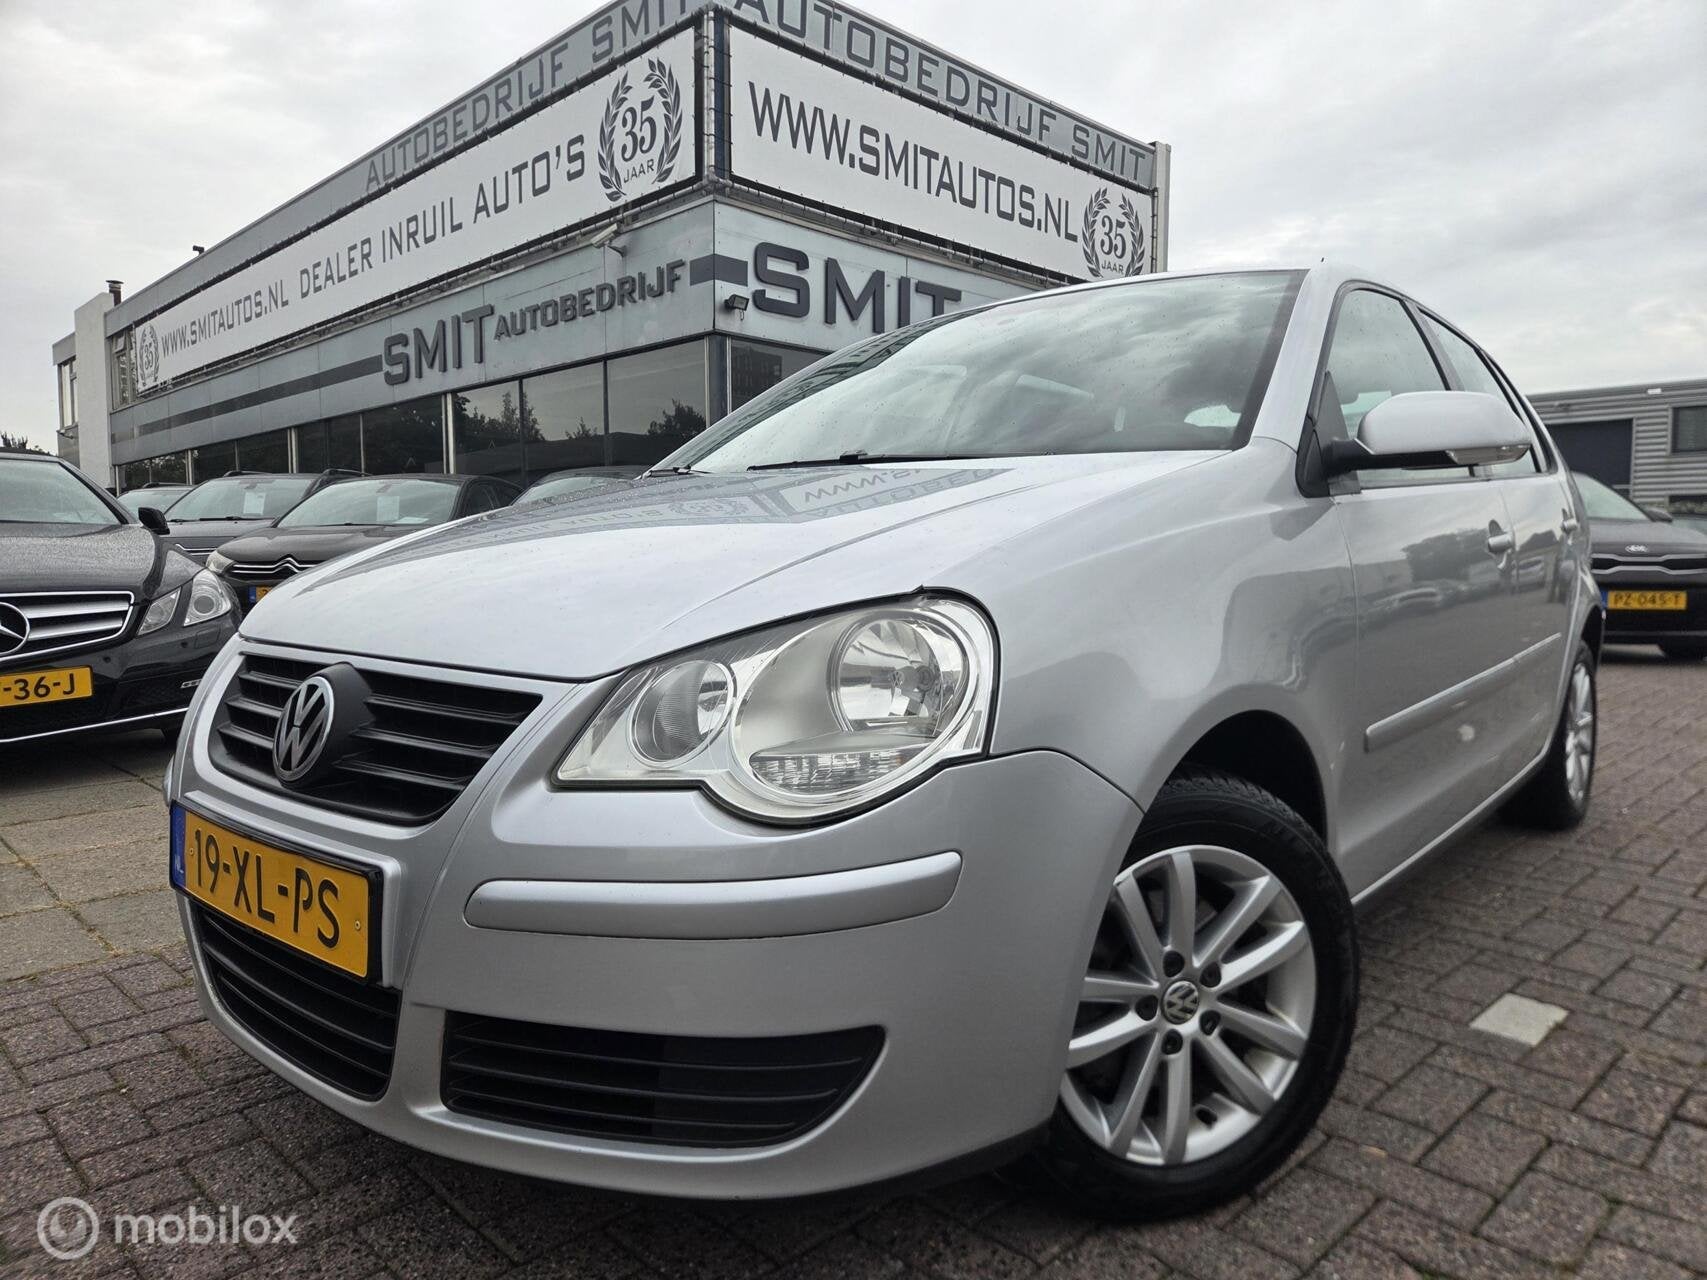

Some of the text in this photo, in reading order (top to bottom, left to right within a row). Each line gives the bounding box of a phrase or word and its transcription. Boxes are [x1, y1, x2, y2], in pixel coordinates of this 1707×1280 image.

[364, 42, 570, 192] AUTOBEDRIJF
[621, 96, 657, 162] 35
[748, 81, 1078, 243] WWW.SMITAUTOS.NL
[1071, 124, 1146, 181] SMIT
[623, 158, 654, 184] JAAR
[161, 134, 585, 358] WWW.SMITAUTOS.NL DEALER INRUIL AUTO'S
[1100, 215, 1126, 259] 35
[1101, 260, 1124, 275] JAAR
[383, 259, 689, 386] SMIT AUTOBEDRIJF
[194, 829, 340, 949] 19-XL-PS
